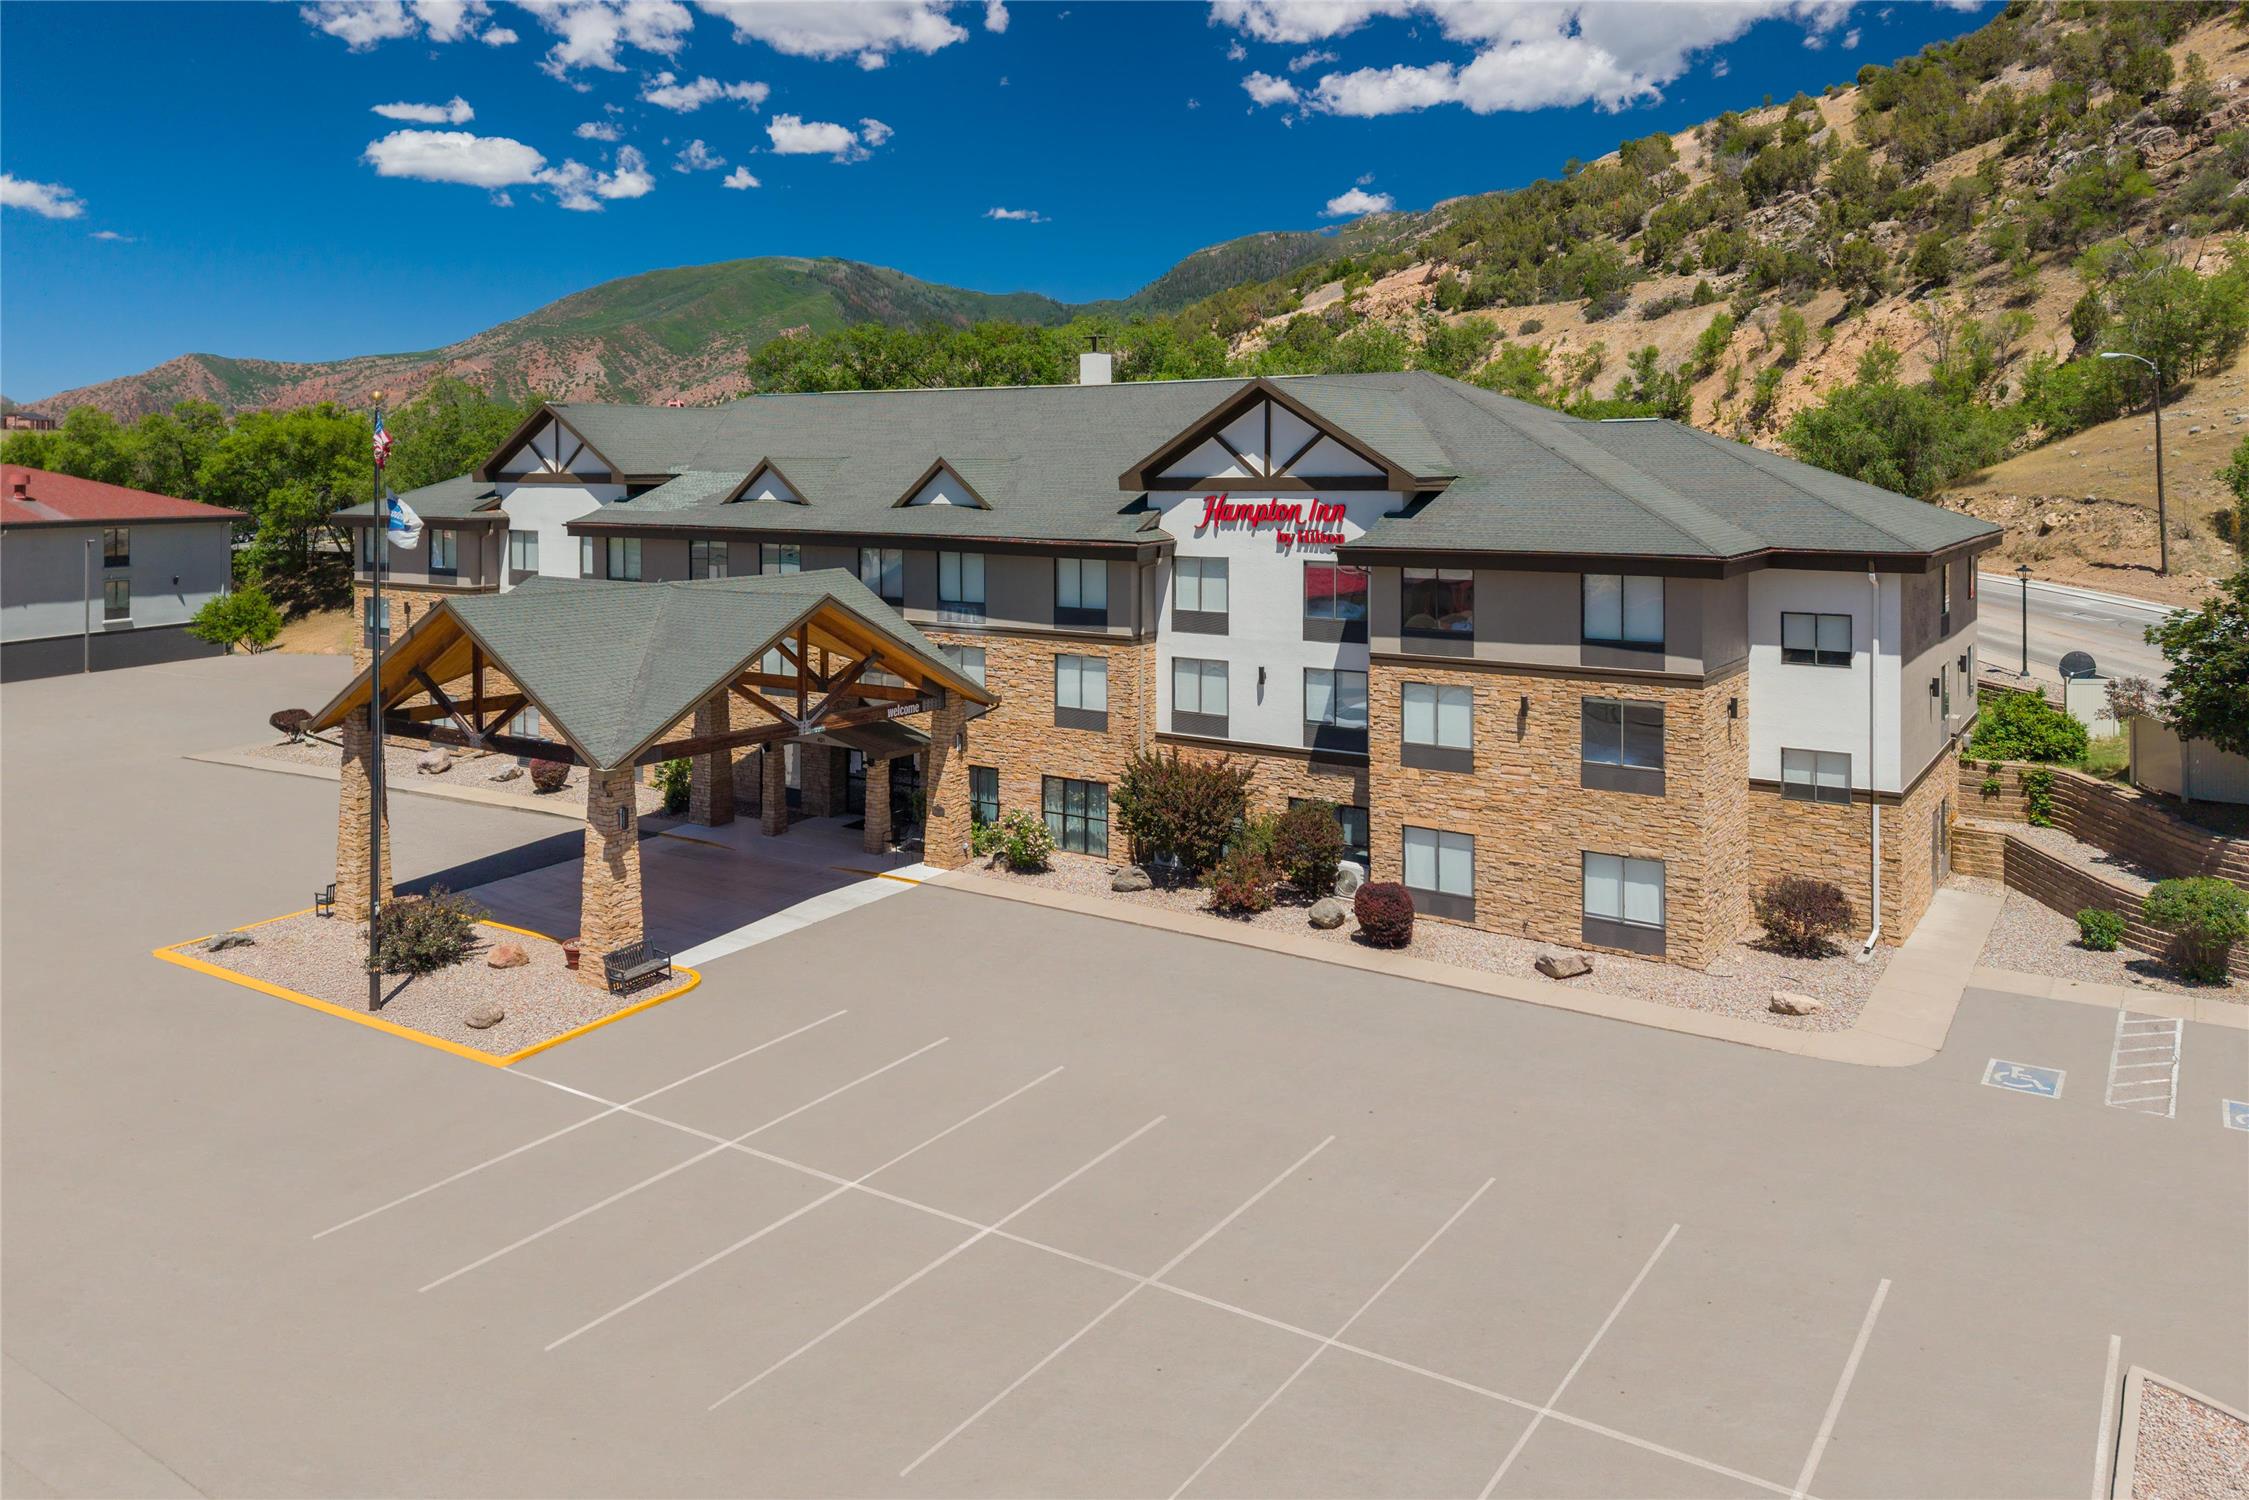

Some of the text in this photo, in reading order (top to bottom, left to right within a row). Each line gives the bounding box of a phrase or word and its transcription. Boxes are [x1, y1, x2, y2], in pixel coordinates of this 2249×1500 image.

[1194, 493, 1346, 528] Hampton Inn
[1276, 529, 1345, 547] by Hilton
[887, 703, 920, 717] welcome
